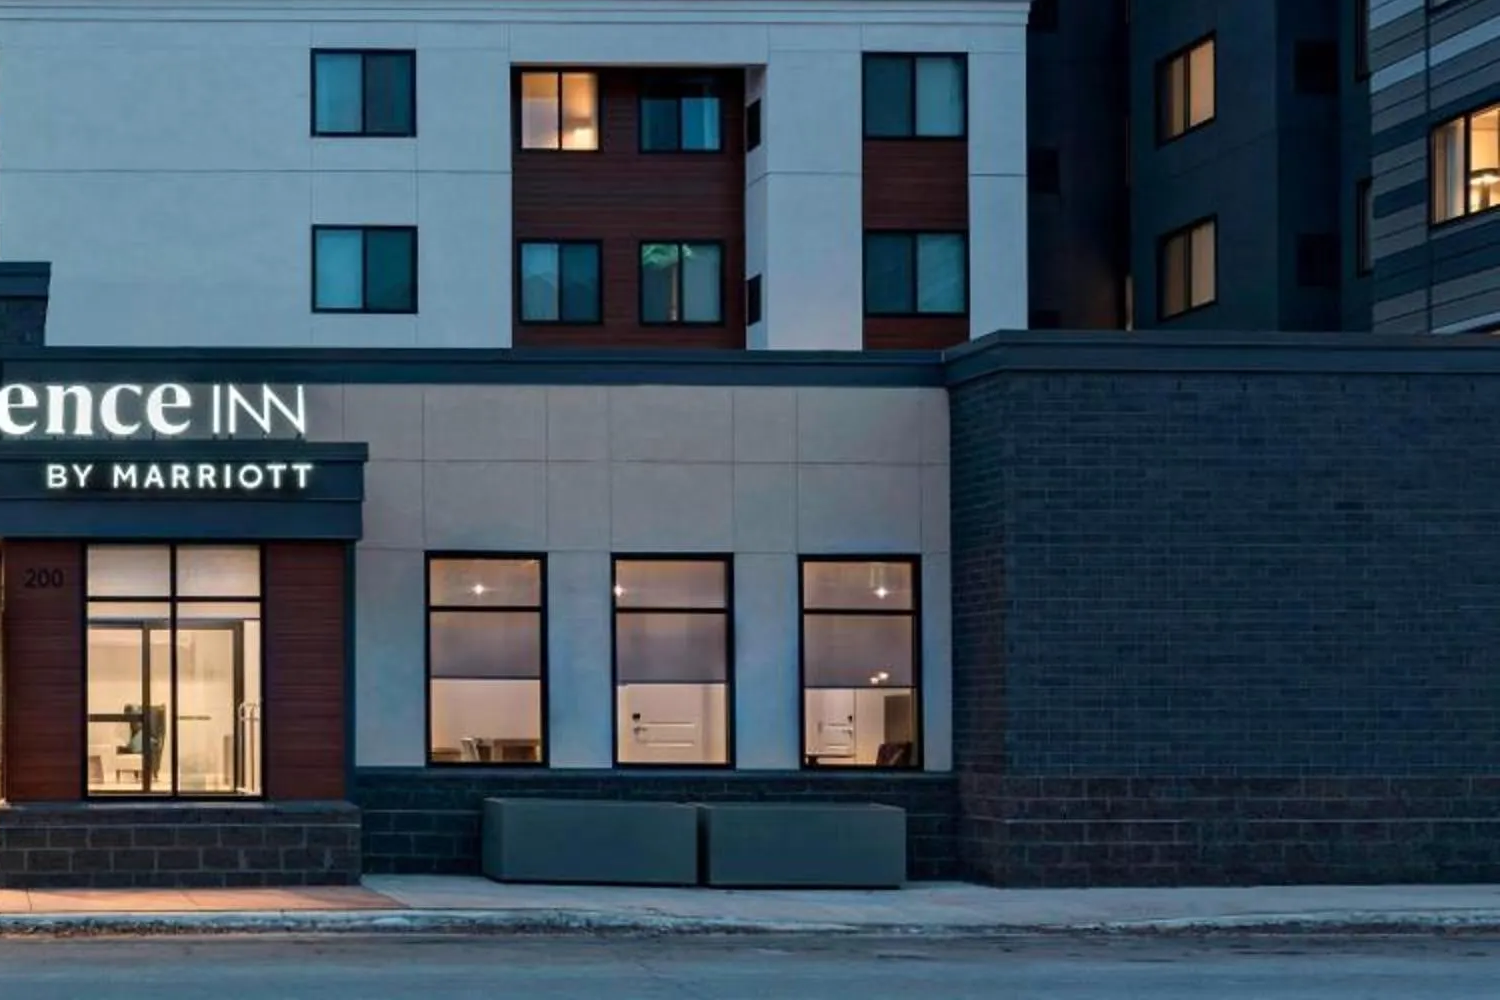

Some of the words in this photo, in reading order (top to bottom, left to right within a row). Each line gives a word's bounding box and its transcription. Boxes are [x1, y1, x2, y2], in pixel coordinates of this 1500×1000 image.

[212, 384, 305, 434] INN
[47, 464, 94, 489] BY
[113, 463, 313, 489] MARRIOTT
[24, 567, 64, 589] 200
